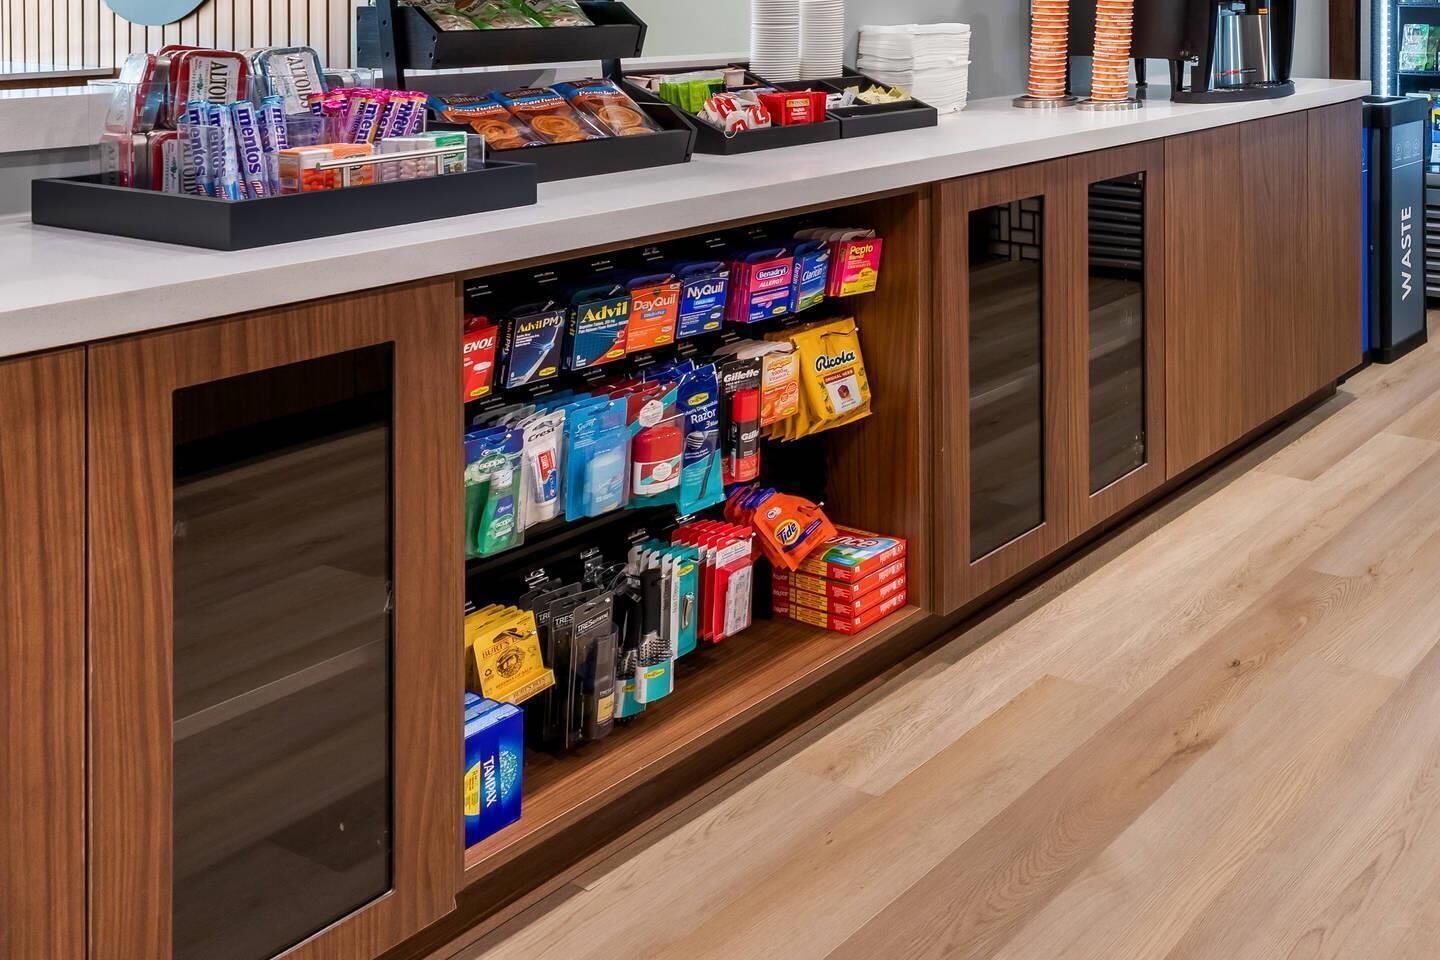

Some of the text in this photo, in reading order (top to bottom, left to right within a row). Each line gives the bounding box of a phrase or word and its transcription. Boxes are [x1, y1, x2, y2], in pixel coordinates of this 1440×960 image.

[286, 55, 312, 109] ALTOIDS
[189, 109, 207, 177] mentos
[237, 108, 263, 174] mentos
[849, 244, 874, 256] Pepto
[1401, 206, 1412, 301] WASTE
[758, 266, 787, 279] Benadryl
[687, 281, 724, 300] NyQuil
[758, 278, 784, 289] ALLERGY
[633, 293, 677, 312] DayQuil
[580, 300, 628, 324] Advil
[517, 317, 559, 334] Advil PM
[814, 349, 856, 372] Ricola
[723, 367, 760, 383] Gillette
[690, 408, 717, 425] Razor
[527, 426, 555, 443] Crest
[479, 457, 506, 469] scope
[494, 517, 514, 529] scope
[776, 523, 797, 545] Tide
[554, 614, 574, 626] TRES
[483, 755, 498, 808] TAMPAX
